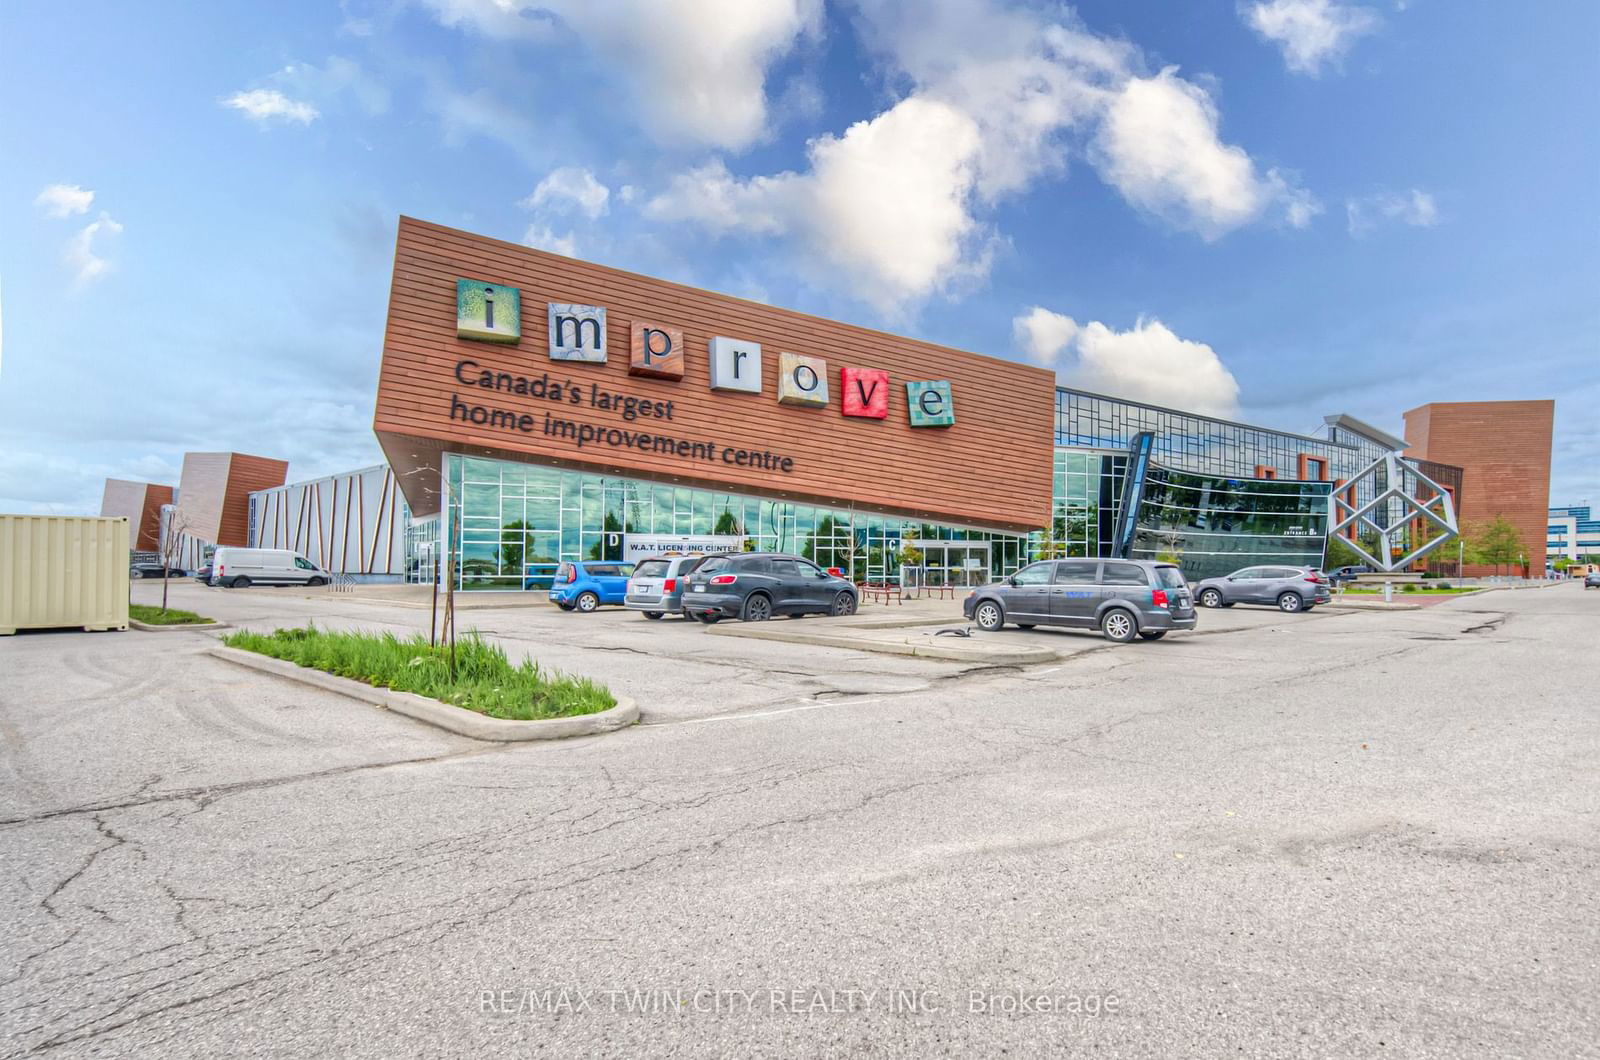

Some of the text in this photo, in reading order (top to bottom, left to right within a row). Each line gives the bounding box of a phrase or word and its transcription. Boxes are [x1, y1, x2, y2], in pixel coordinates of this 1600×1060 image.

[484, 287, 944, 416] improve
[455, 360, 674, 421] Canada's largest
[450, 394, 794, 472] home improvement centre
[609, 533, 619, 547] D
[657, 544, 703, 552] LICENING
[889, 539, 896, 551] C
